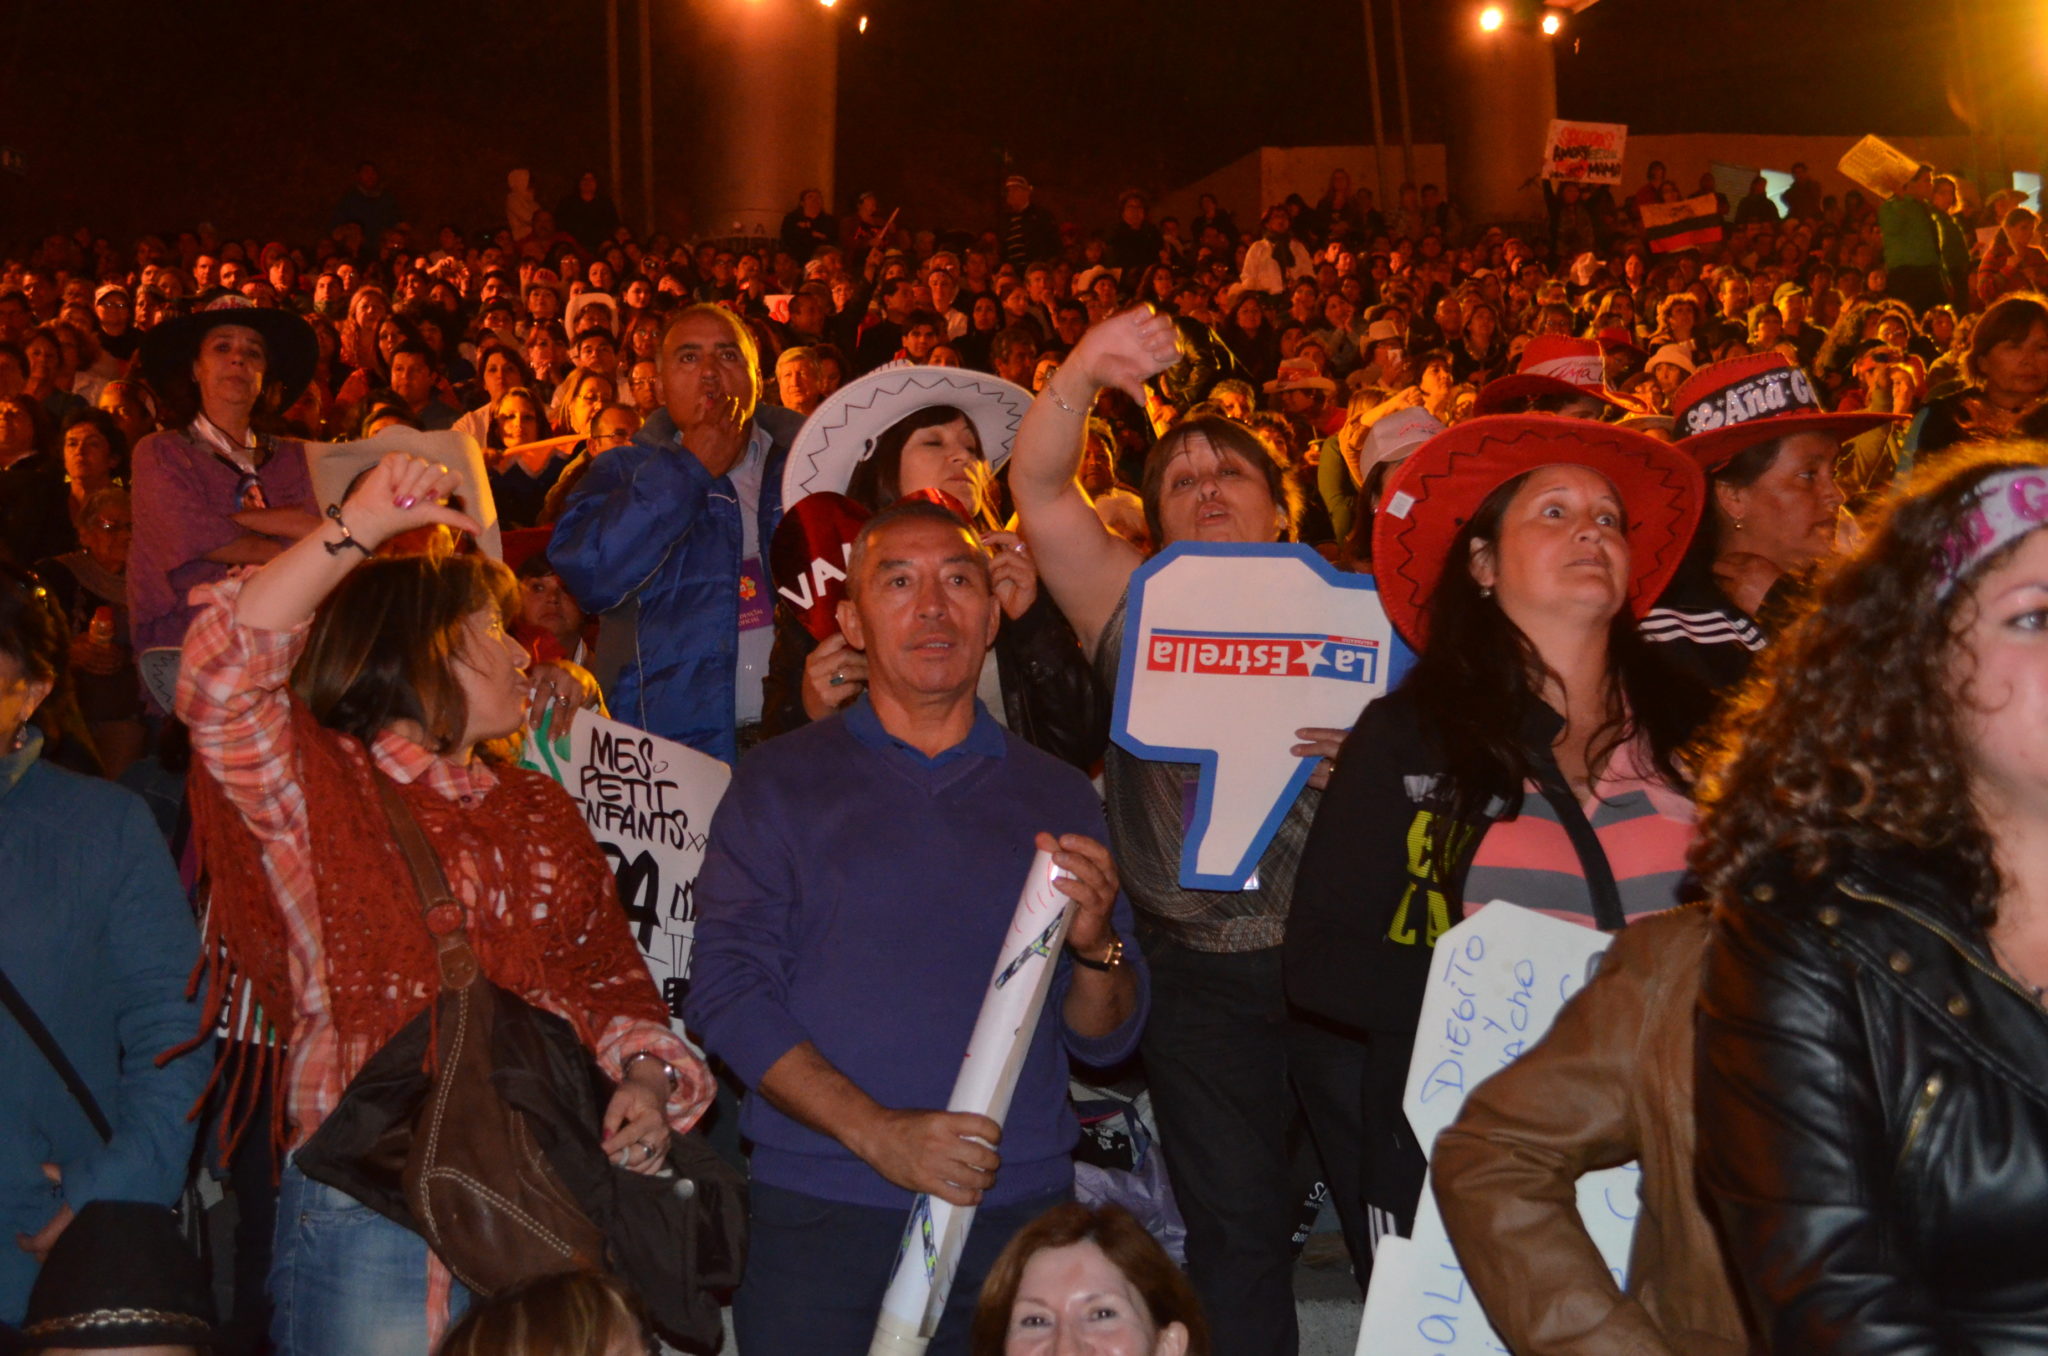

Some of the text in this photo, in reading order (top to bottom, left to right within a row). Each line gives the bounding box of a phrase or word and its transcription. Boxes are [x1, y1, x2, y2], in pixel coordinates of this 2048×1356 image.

[1725, 368, 1817, 427] Ana G
[777, 542, 852, 610] VA
[1152, 640, 1374, 683] La Estrella
